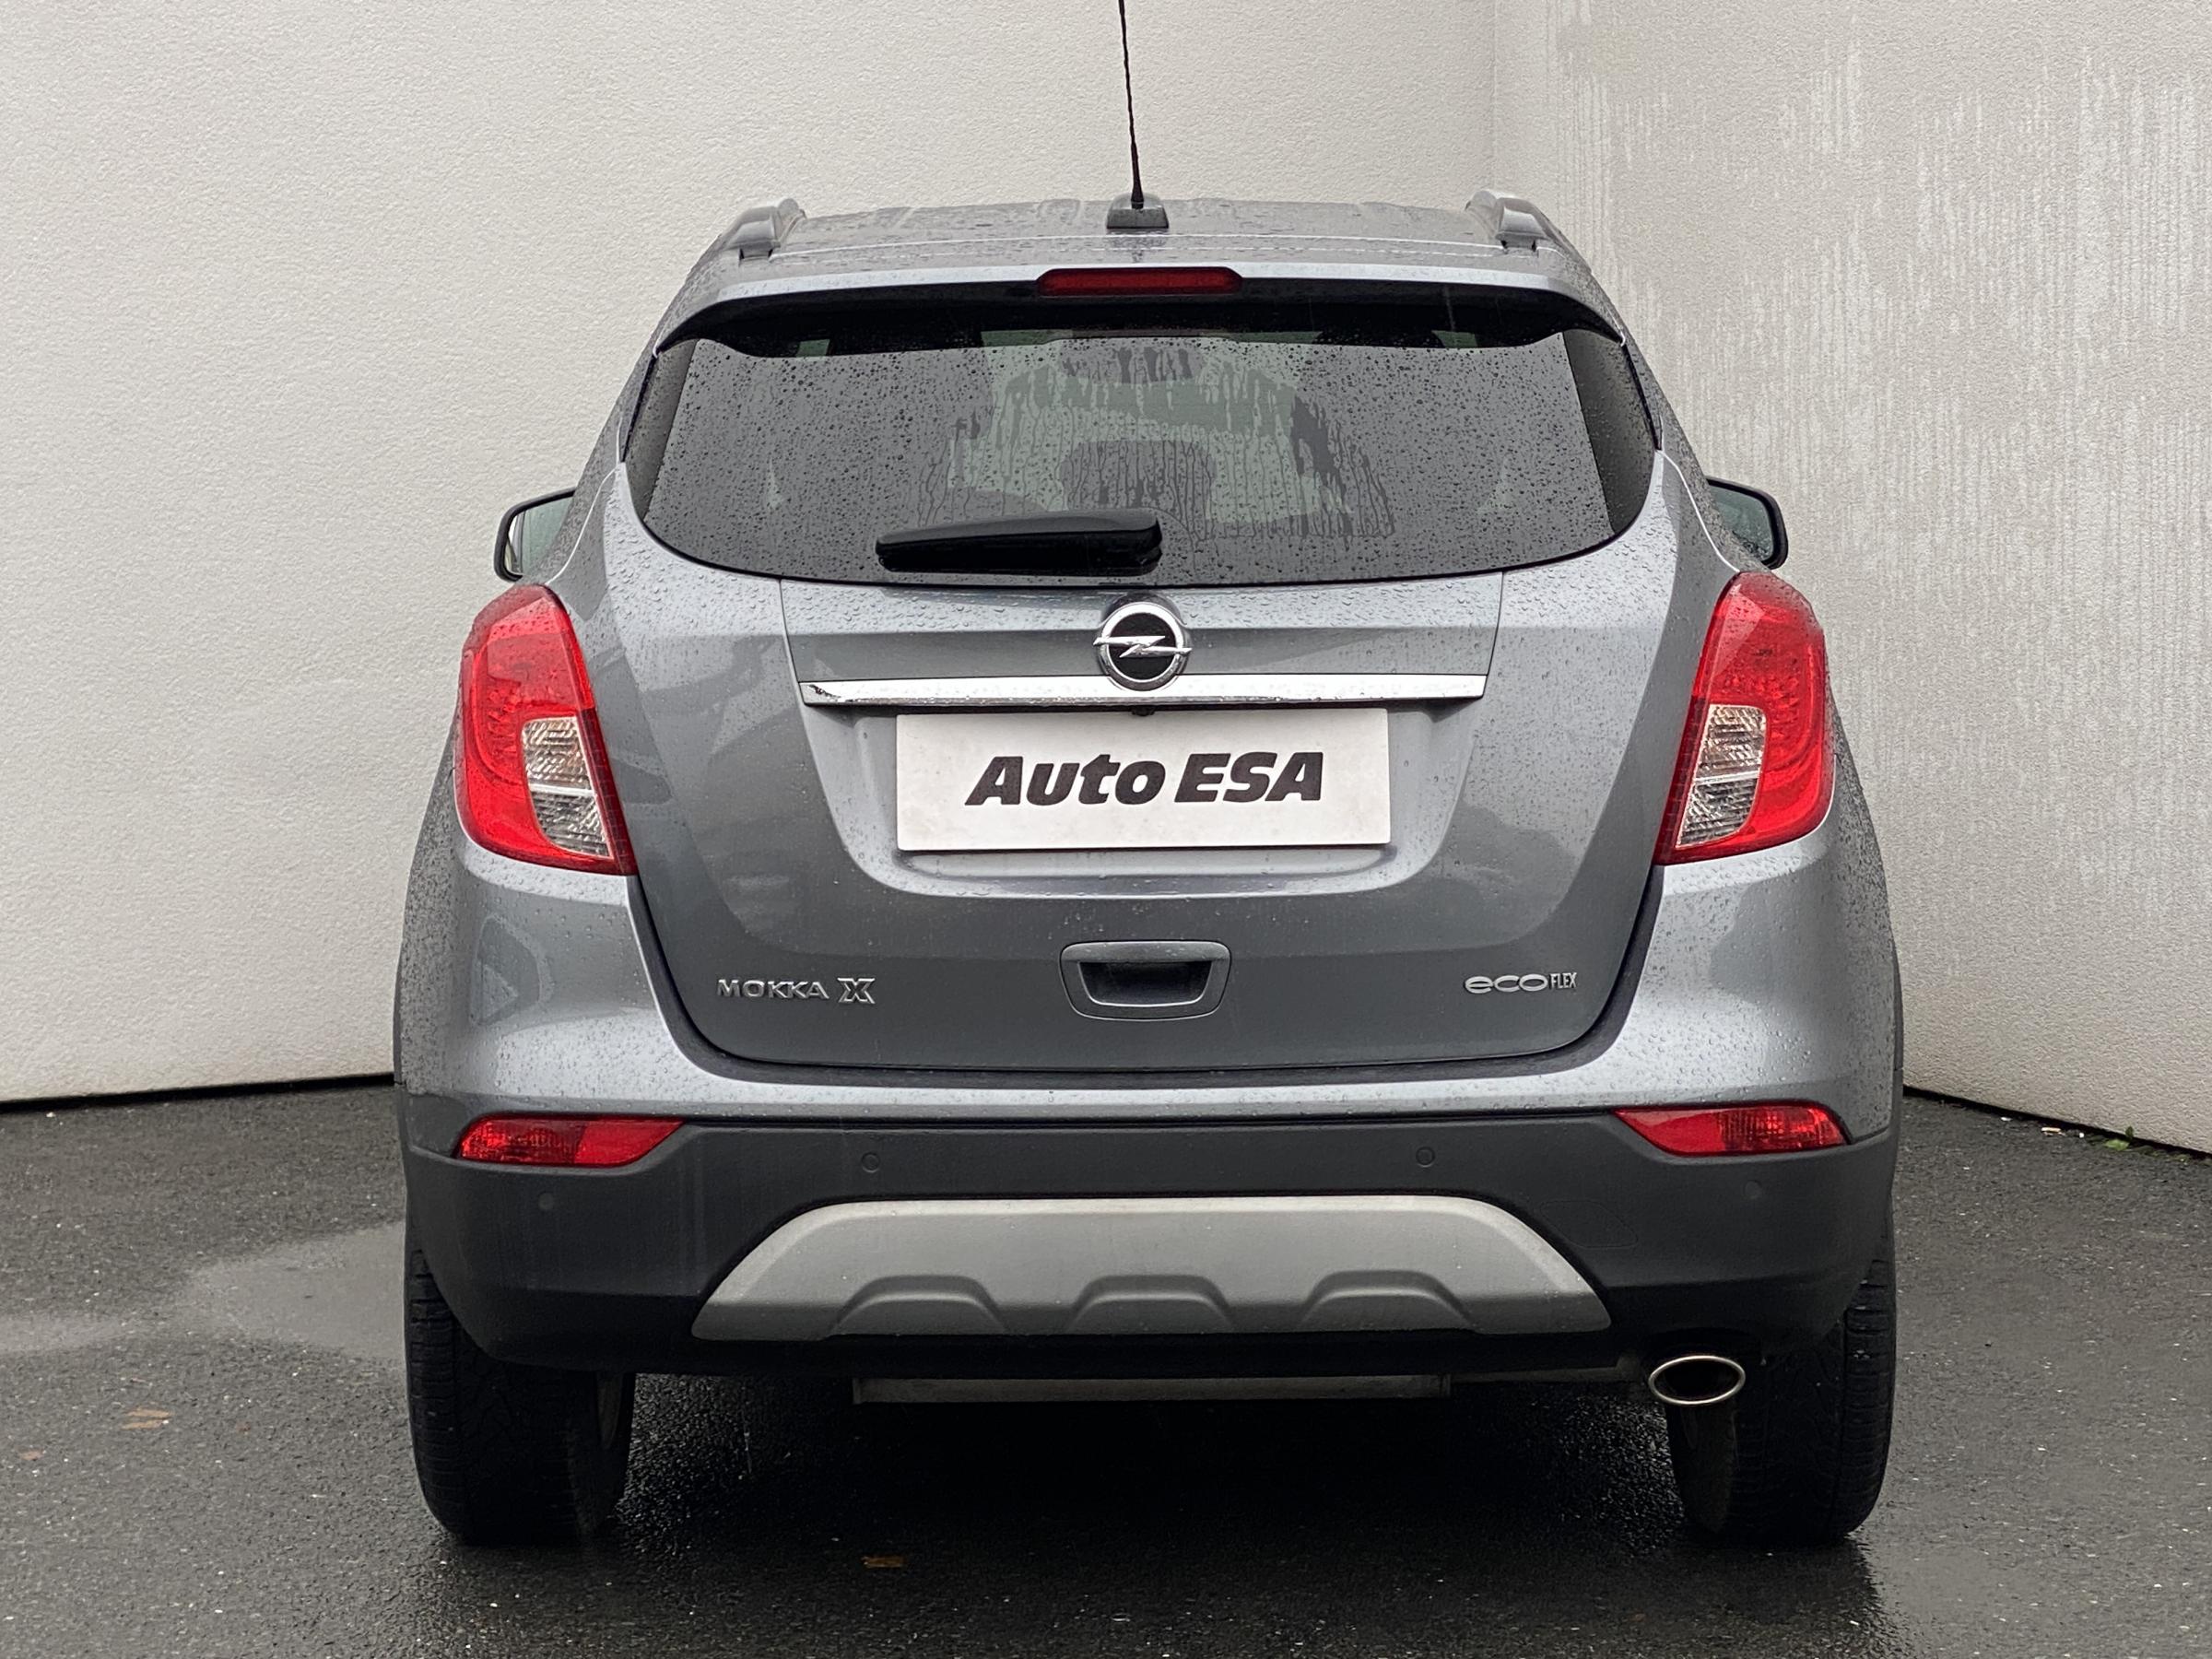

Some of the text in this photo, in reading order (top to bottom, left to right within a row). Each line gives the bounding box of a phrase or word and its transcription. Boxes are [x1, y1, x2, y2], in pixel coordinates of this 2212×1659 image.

[964, 751, 1324, 806] Auto ESA
[717, 977, 876, 1004] MOKKA X
